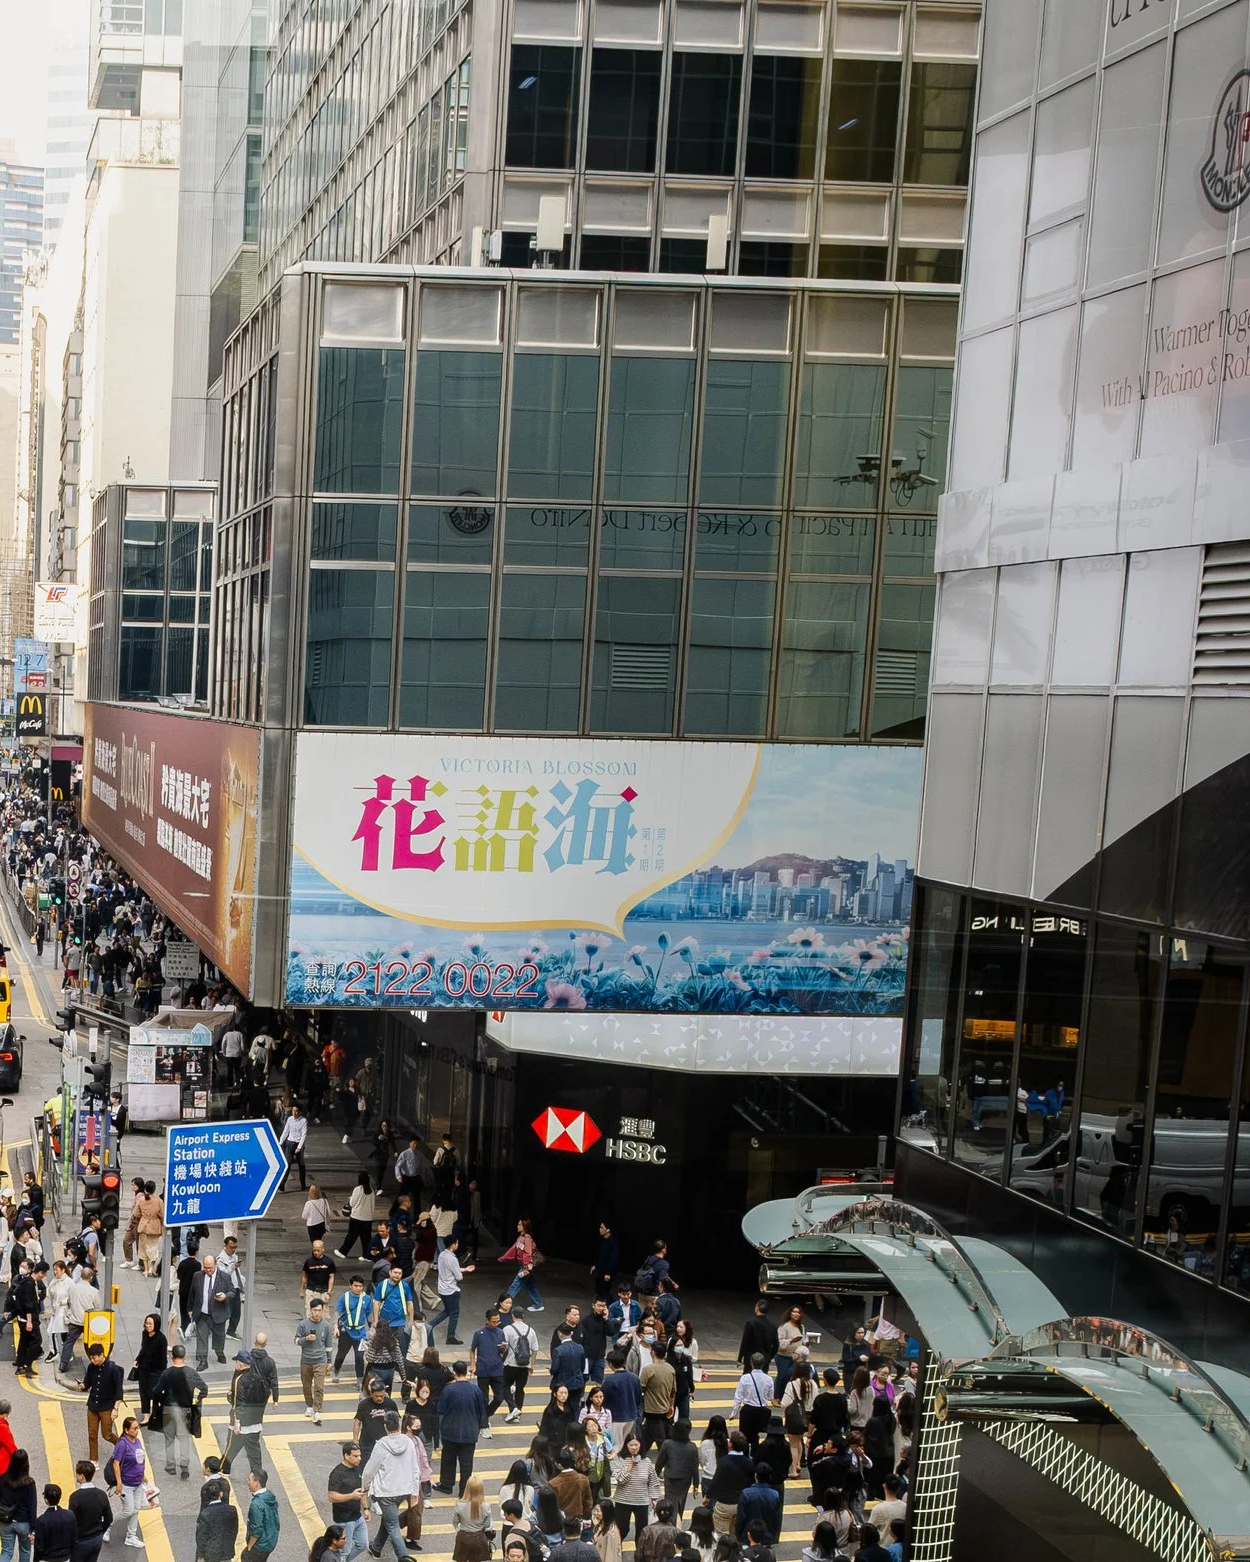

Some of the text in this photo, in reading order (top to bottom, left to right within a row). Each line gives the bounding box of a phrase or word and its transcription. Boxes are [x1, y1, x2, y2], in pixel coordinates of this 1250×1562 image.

[1154, 320, 1214, 353] Warmer
[1102, 376, 1131, 408] With
[1154, 364, 1203, 397] Pacino
[440, 757, 638, 776] VICTORIA BLOSSOM
[350, 773, 639, 876] 花語海
[304, 961, 337, 977] 查詢
[304, 978, 337, 994] 熱線
[344, 960, 540, 998] 2122 0022
[174, 1132, 250, 1146] Airport Express
[173, 1147, 215, 1161] Station
[605, 1138, 667, 1164] HSBC
[173, 1159, 248, 1181] 機場快綫站
[171, 1182, 221, 1196] Kowloon
[171, 1198, 201, 1216] 九龍
